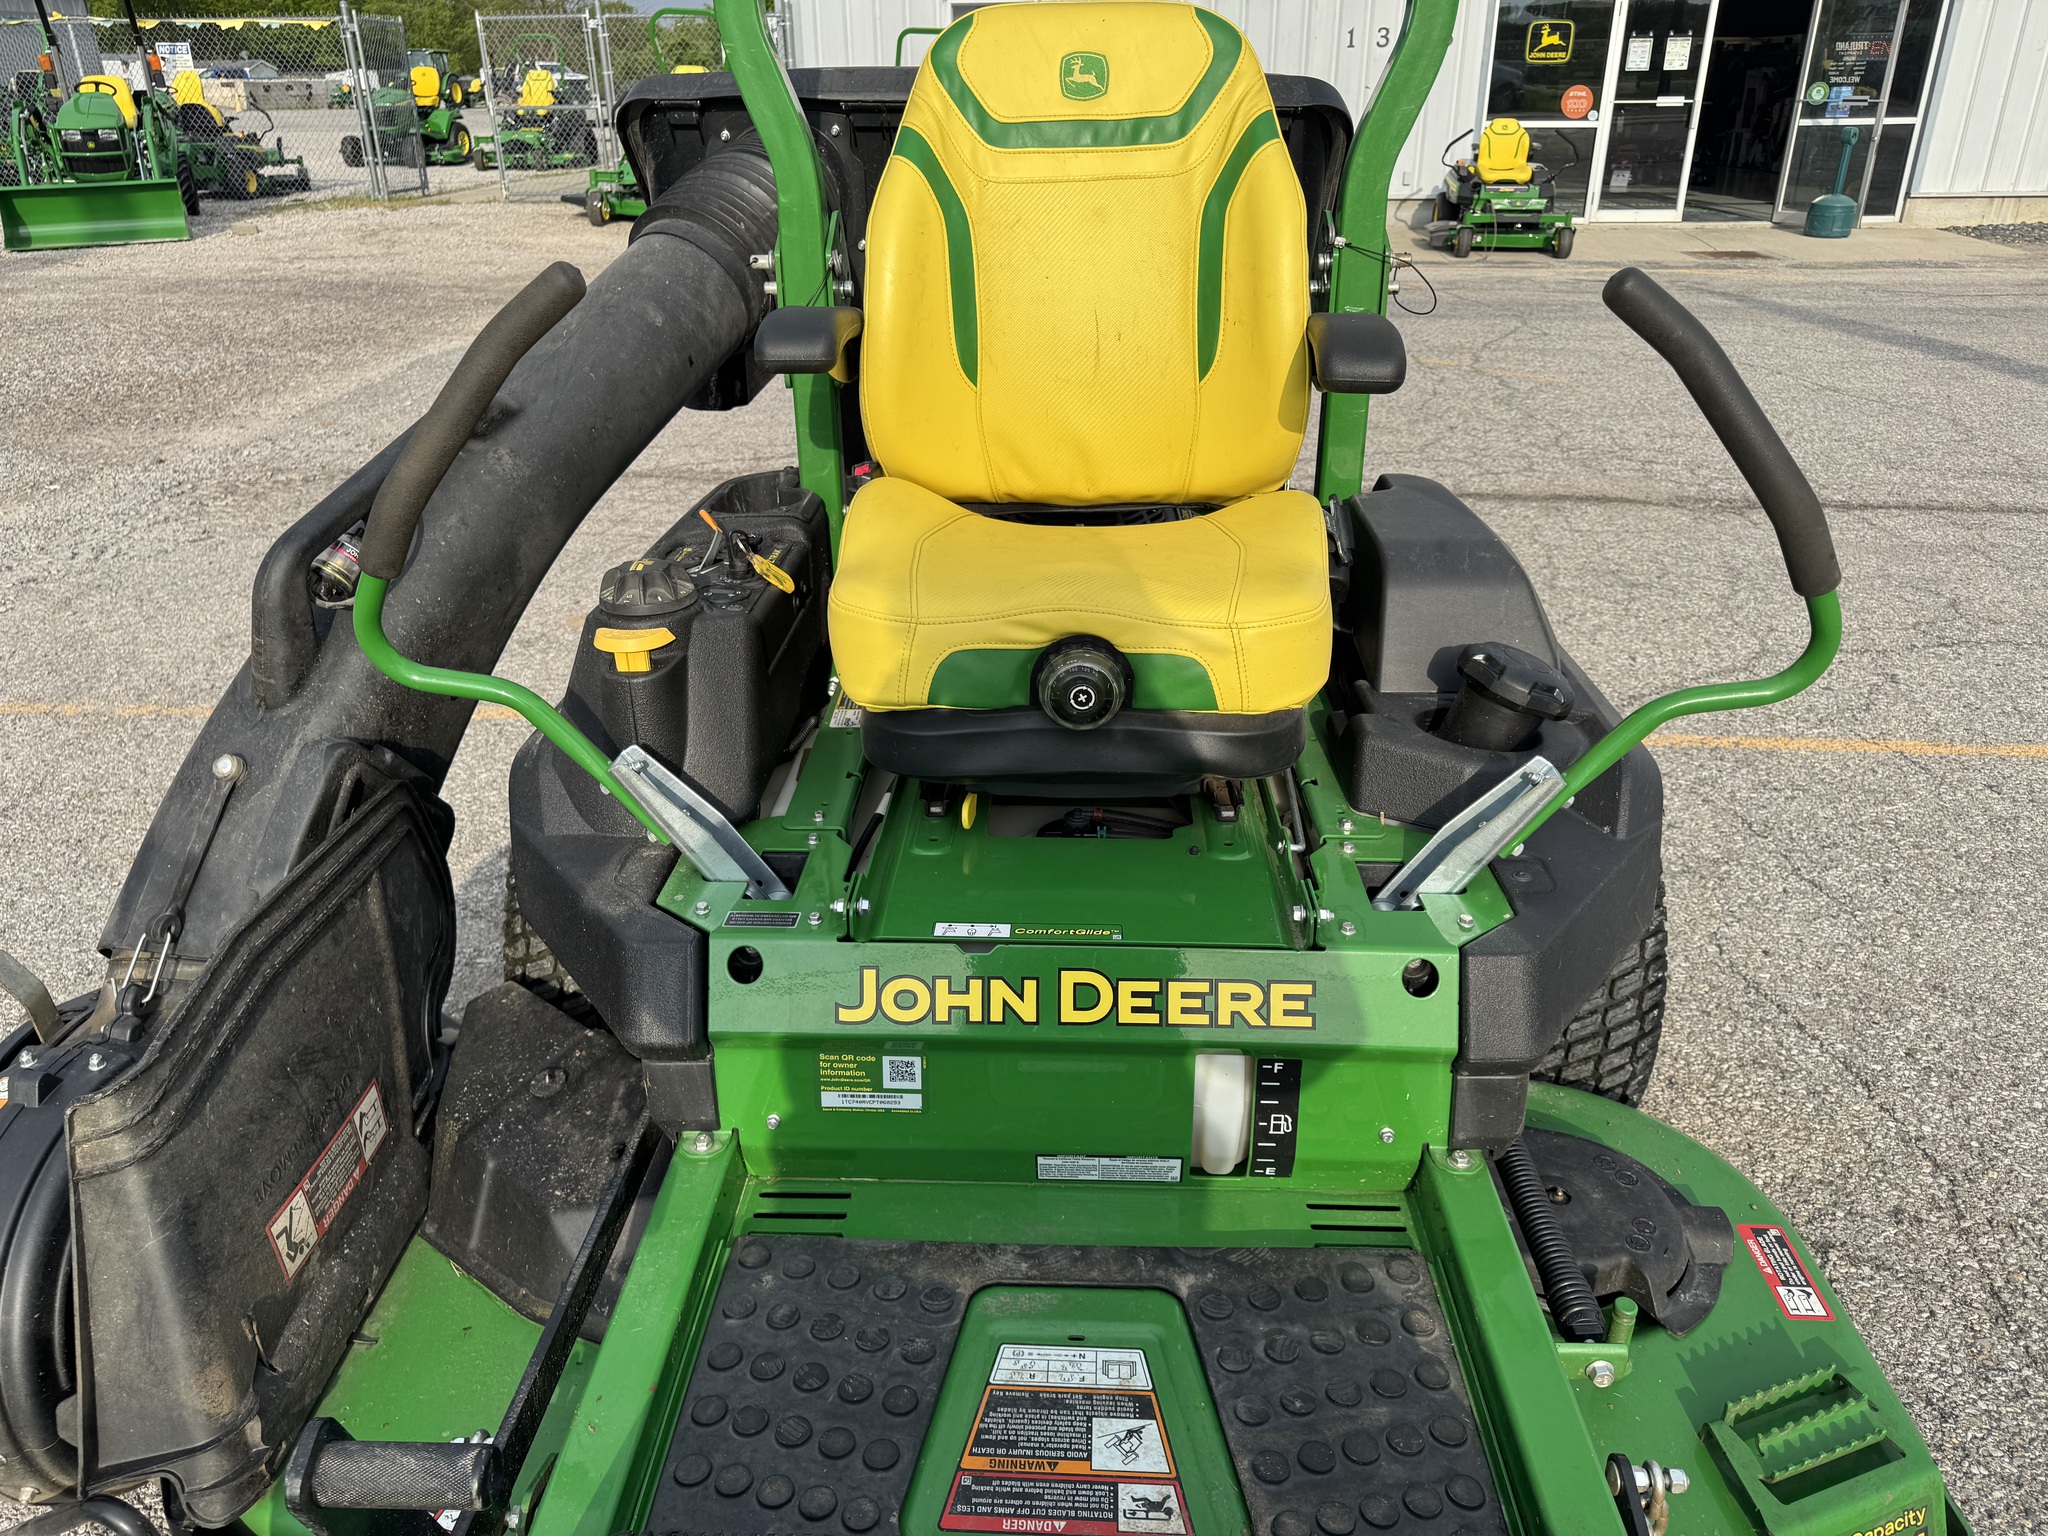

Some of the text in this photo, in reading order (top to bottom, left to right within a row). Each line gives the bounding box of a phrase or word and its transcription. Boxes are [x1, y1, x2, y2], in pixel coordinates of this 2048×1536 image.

[159, 45, 188, 54] NOTICE
[835, 965, 1316, 1030] JOHN DEERE
[1273, 1062, 1284, 1073] F
[1265, 1167, 1276, 1175] E
[323, 1178, 354, 1228] DANGER
[1747, 1239, 1767, 1267] DANGER
[989, 1459, 1045, 1470] WARNING
[1048, 1509, 1075, 1517] BLADES
[1078, 1510, 1113, 1518] ROTATING
[1002, 1519, 1052, 1532] DANGER
[1852, 1507, 1927, 1536] pacity
